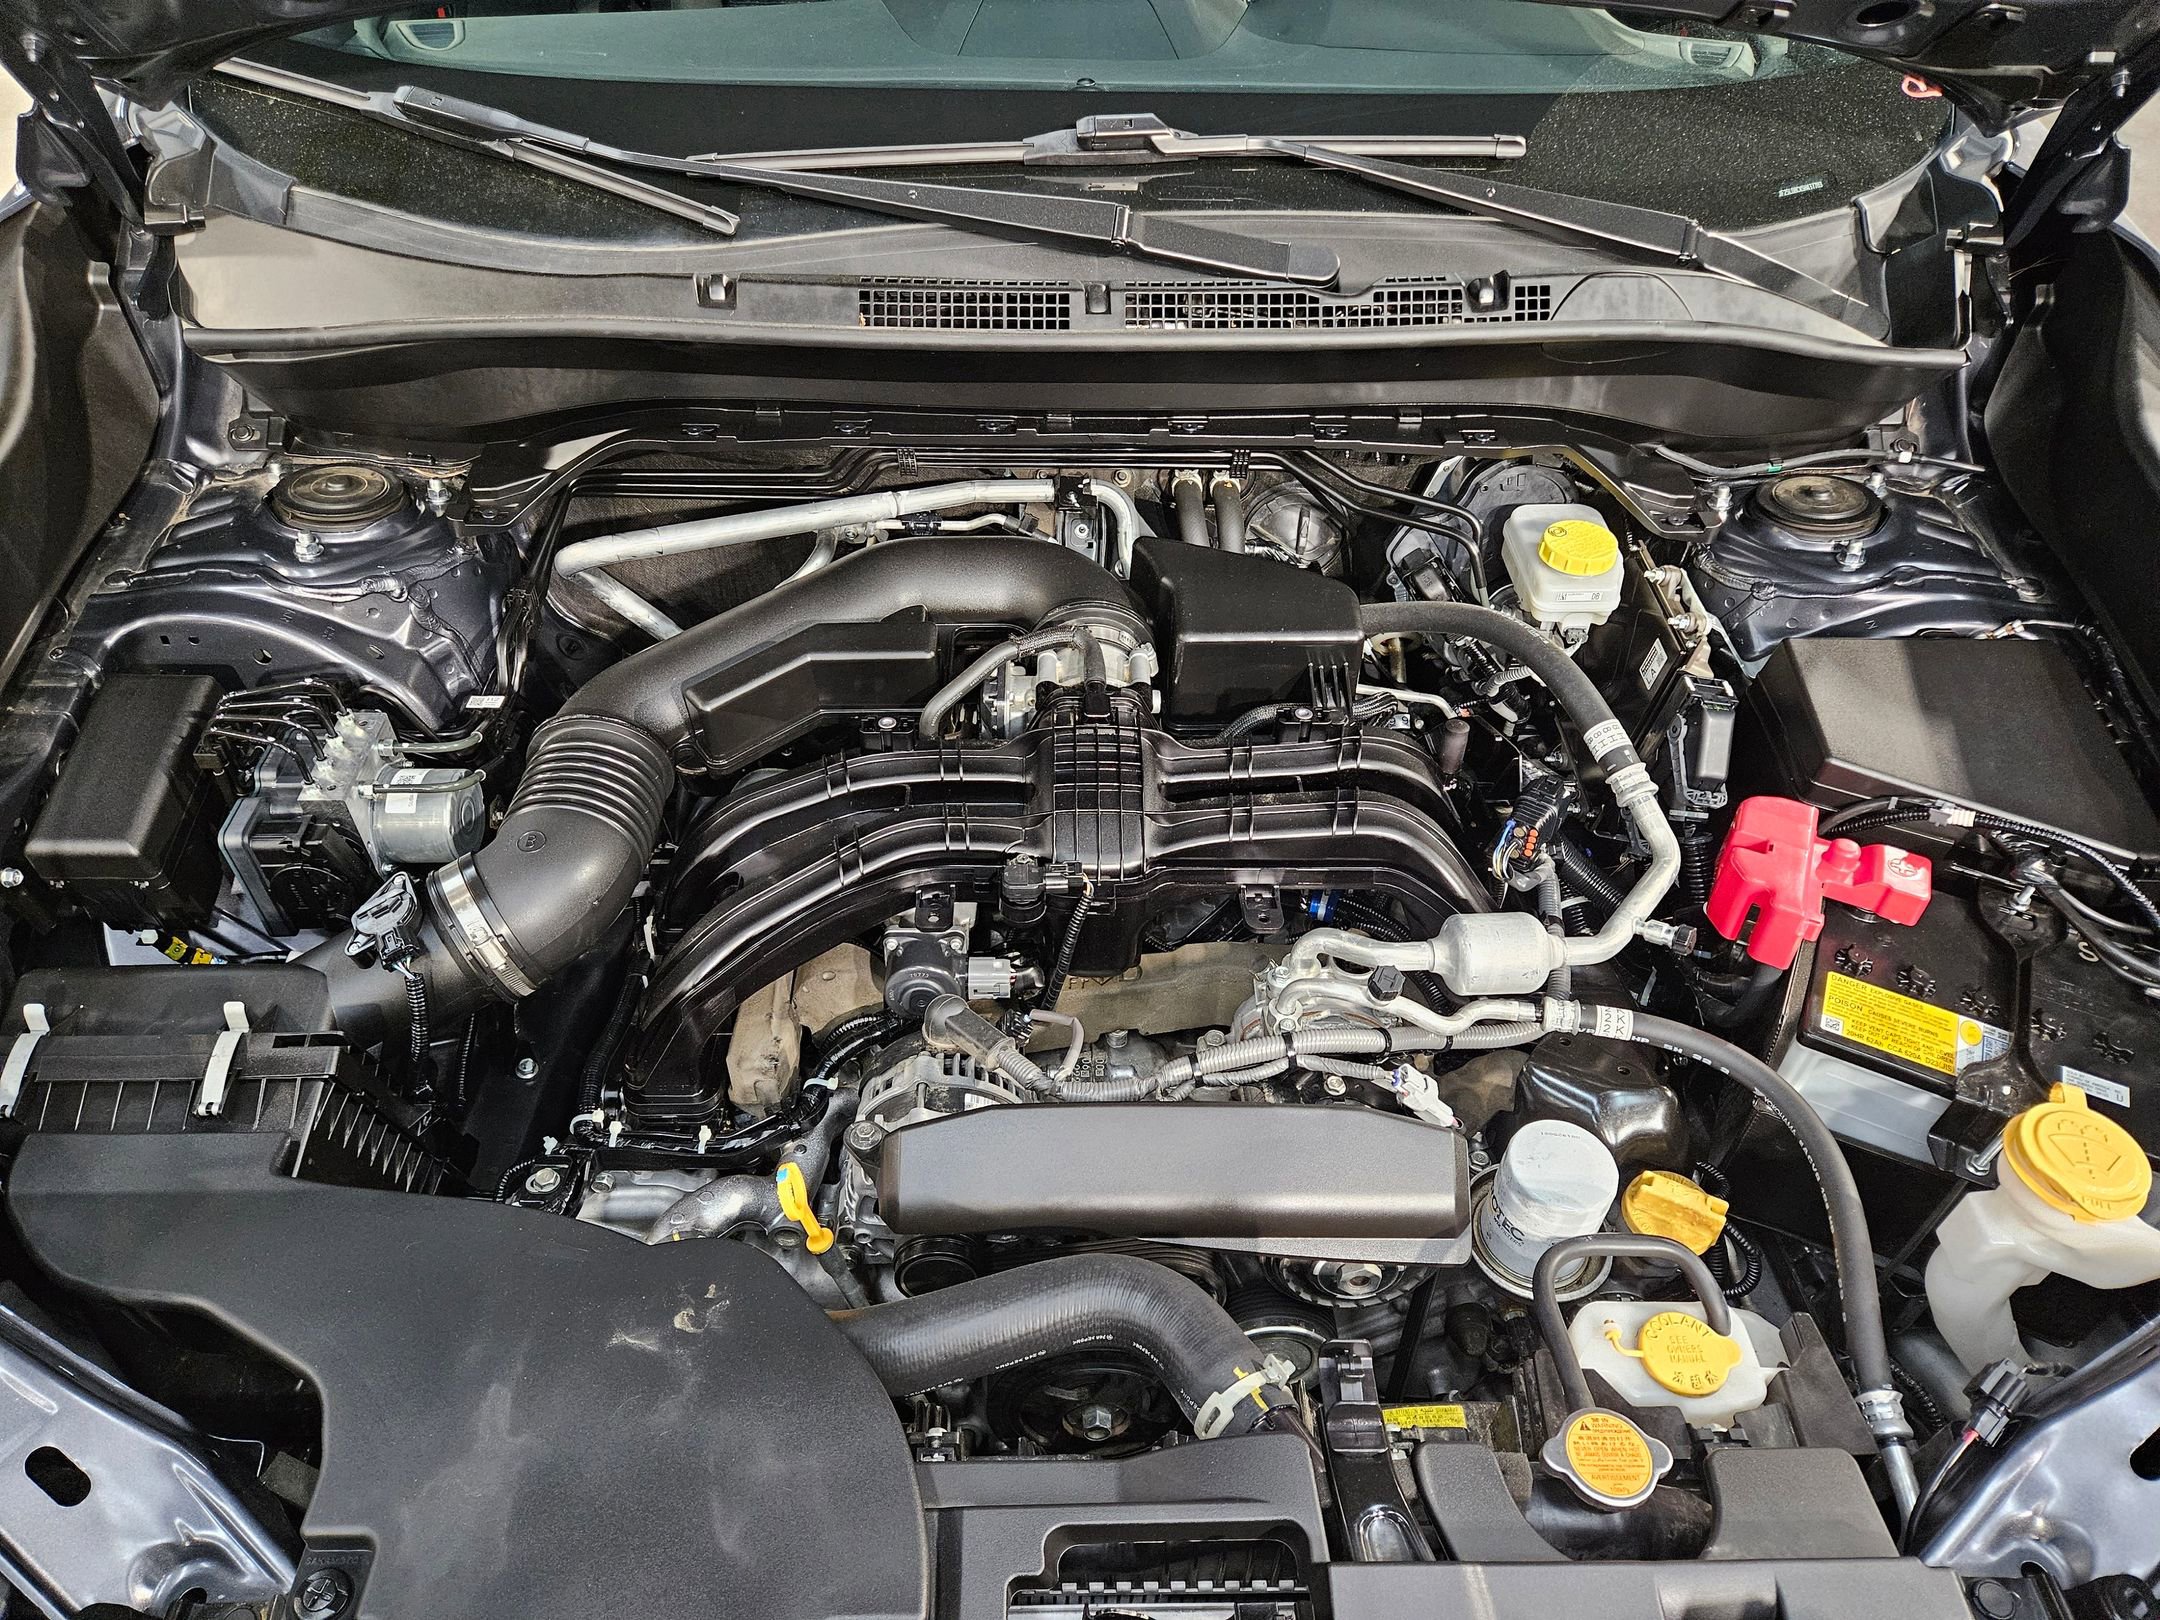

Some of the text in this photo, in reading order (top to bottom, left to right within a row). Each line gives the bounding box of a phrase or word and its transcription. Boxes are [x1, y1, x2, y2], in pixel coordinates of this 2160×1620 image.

[1831, 974, 1924, 1010] DANGER EXPLOSIVE GASES
[1828, 996, 1939, 1038] POISON CAUSES SEVERE BURNS
[1851, 1025, 1867, 1034] KEEP
[1868, 1030, 1880, 1038] OUT
[1891, 1038, 1912, 1050] REACH
[1914, 1044, 1921, 1052] OF
[1923, 1048, 1954, 1064] CHILDREN
[1852, 1019, 1868, 1028] KEEP
[1869, 1024, 1884, 1034] VENT
[1886, 1030, 1902, 1040] CAPS
[1904, 1036, 1920, 1046] TIGHT
[1922, 1043, 1935, 1051] AND
[1887, 1043, 1902, 1054] CCA
[1764, 1096, 1797, 1136] YOKOHAMA
[1645, 1314, 1712, 1340] COOLANT
[1669, 1336, 1688, 1344] SEE
[1666, 1344, 1704, 1353] OWNERS
[1668, 1354, 1708, 1363] MANUAL
[1592, 1474, 1640, 1482] AVERTISSEMENT
